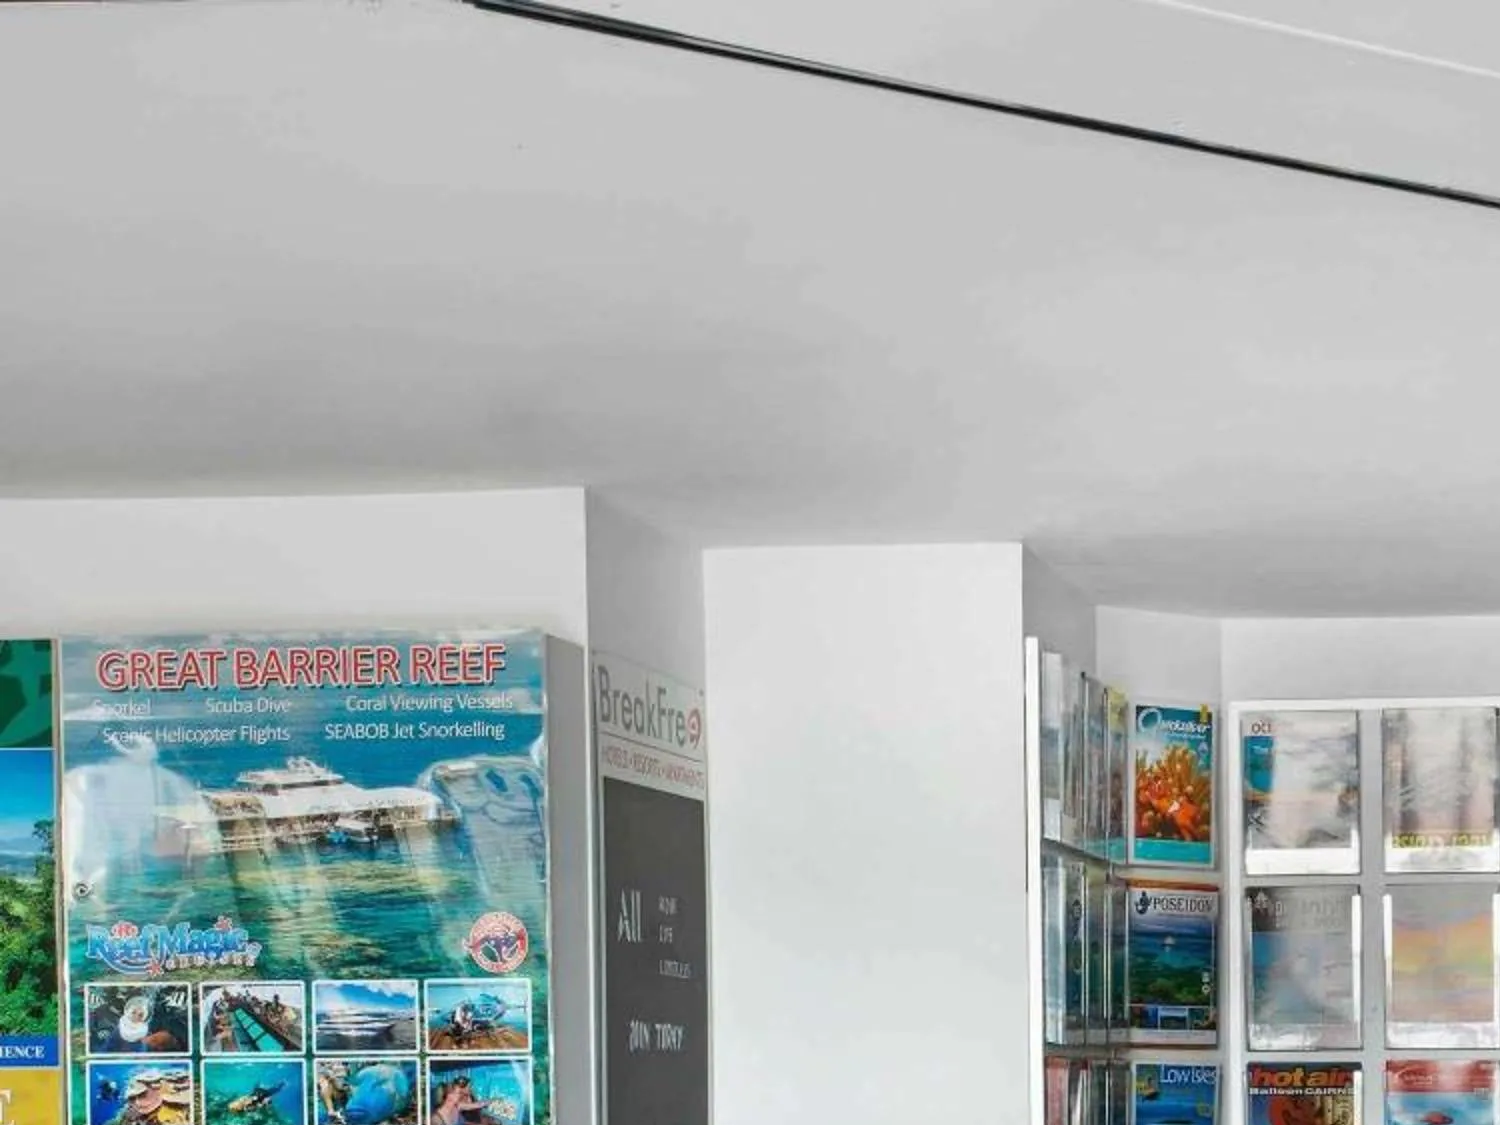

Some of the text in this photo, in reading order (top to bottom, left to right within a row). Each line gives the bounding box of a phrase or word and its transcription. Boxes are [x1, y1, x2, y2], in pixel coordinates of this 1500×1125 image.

[96, 643, 506, 691] GREAT BARRIER REEF
[205, 698, 252, 713] Scuba
[257, 697, 291, 713] Dive
[346, 692, 513, 713] Coral Viewing Vessels
[155, 726, 236, 745] Helicopter
[241, 724, 290, 744] Flights
[324, 720, 505, 740] SEABOB Jet Snorkelling
[1252, 1067, 1305, 1088] hot
